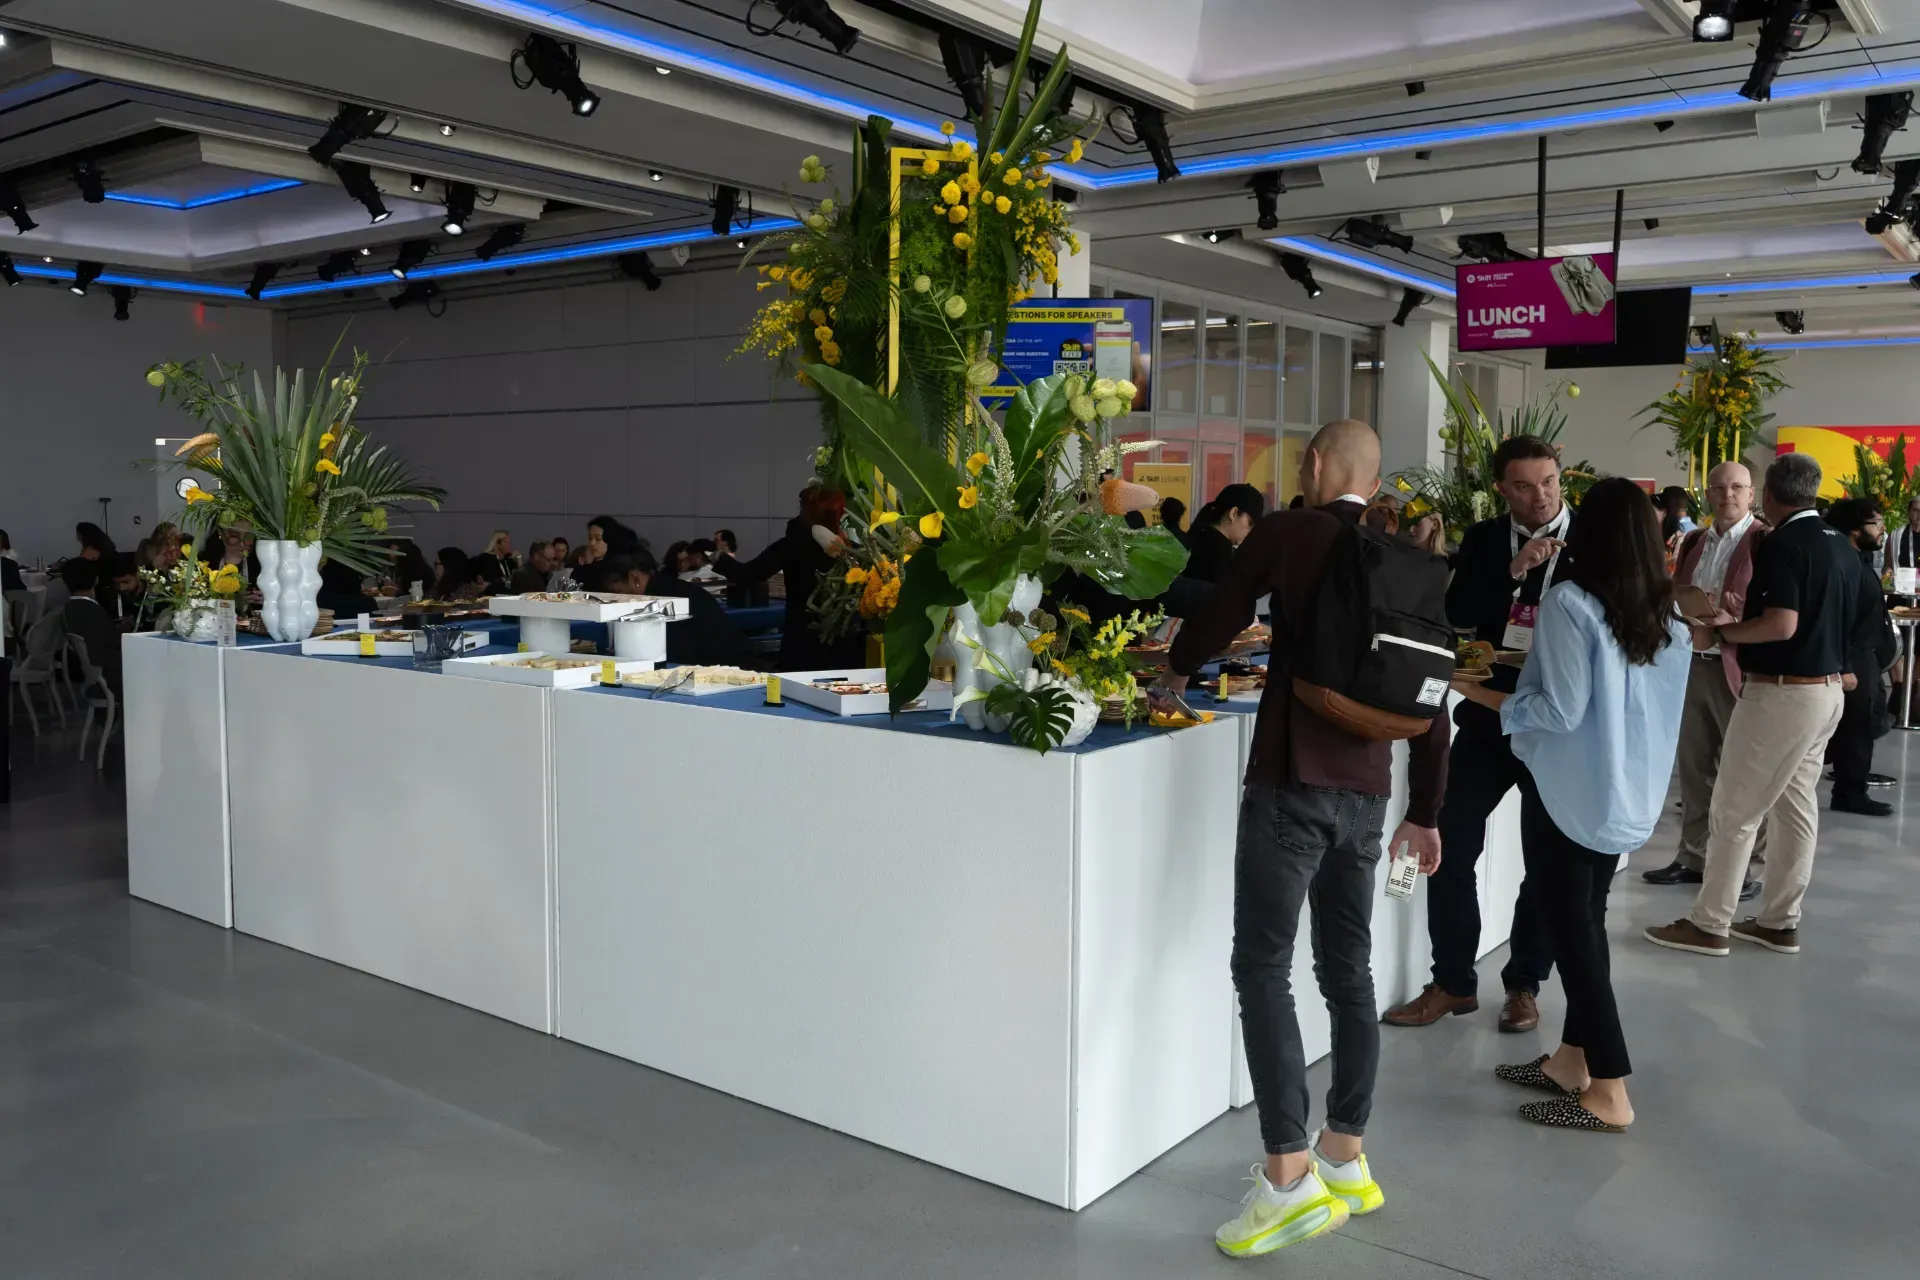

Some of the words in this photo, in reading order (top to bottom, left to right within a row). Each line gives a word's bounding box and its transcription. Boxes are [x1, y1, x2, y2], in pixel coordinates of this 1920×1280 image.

[1047, 311, 1065, 319] FOR
[1066, 311, 1113, 319] SPEAKERS
[1467, 305, 1545, 327] LUNCH
[1062, 343, 1081, 351] Skift
[1401, 865, 1416, 889] BETTER.
[1390, 878, 1401, 887] IS
